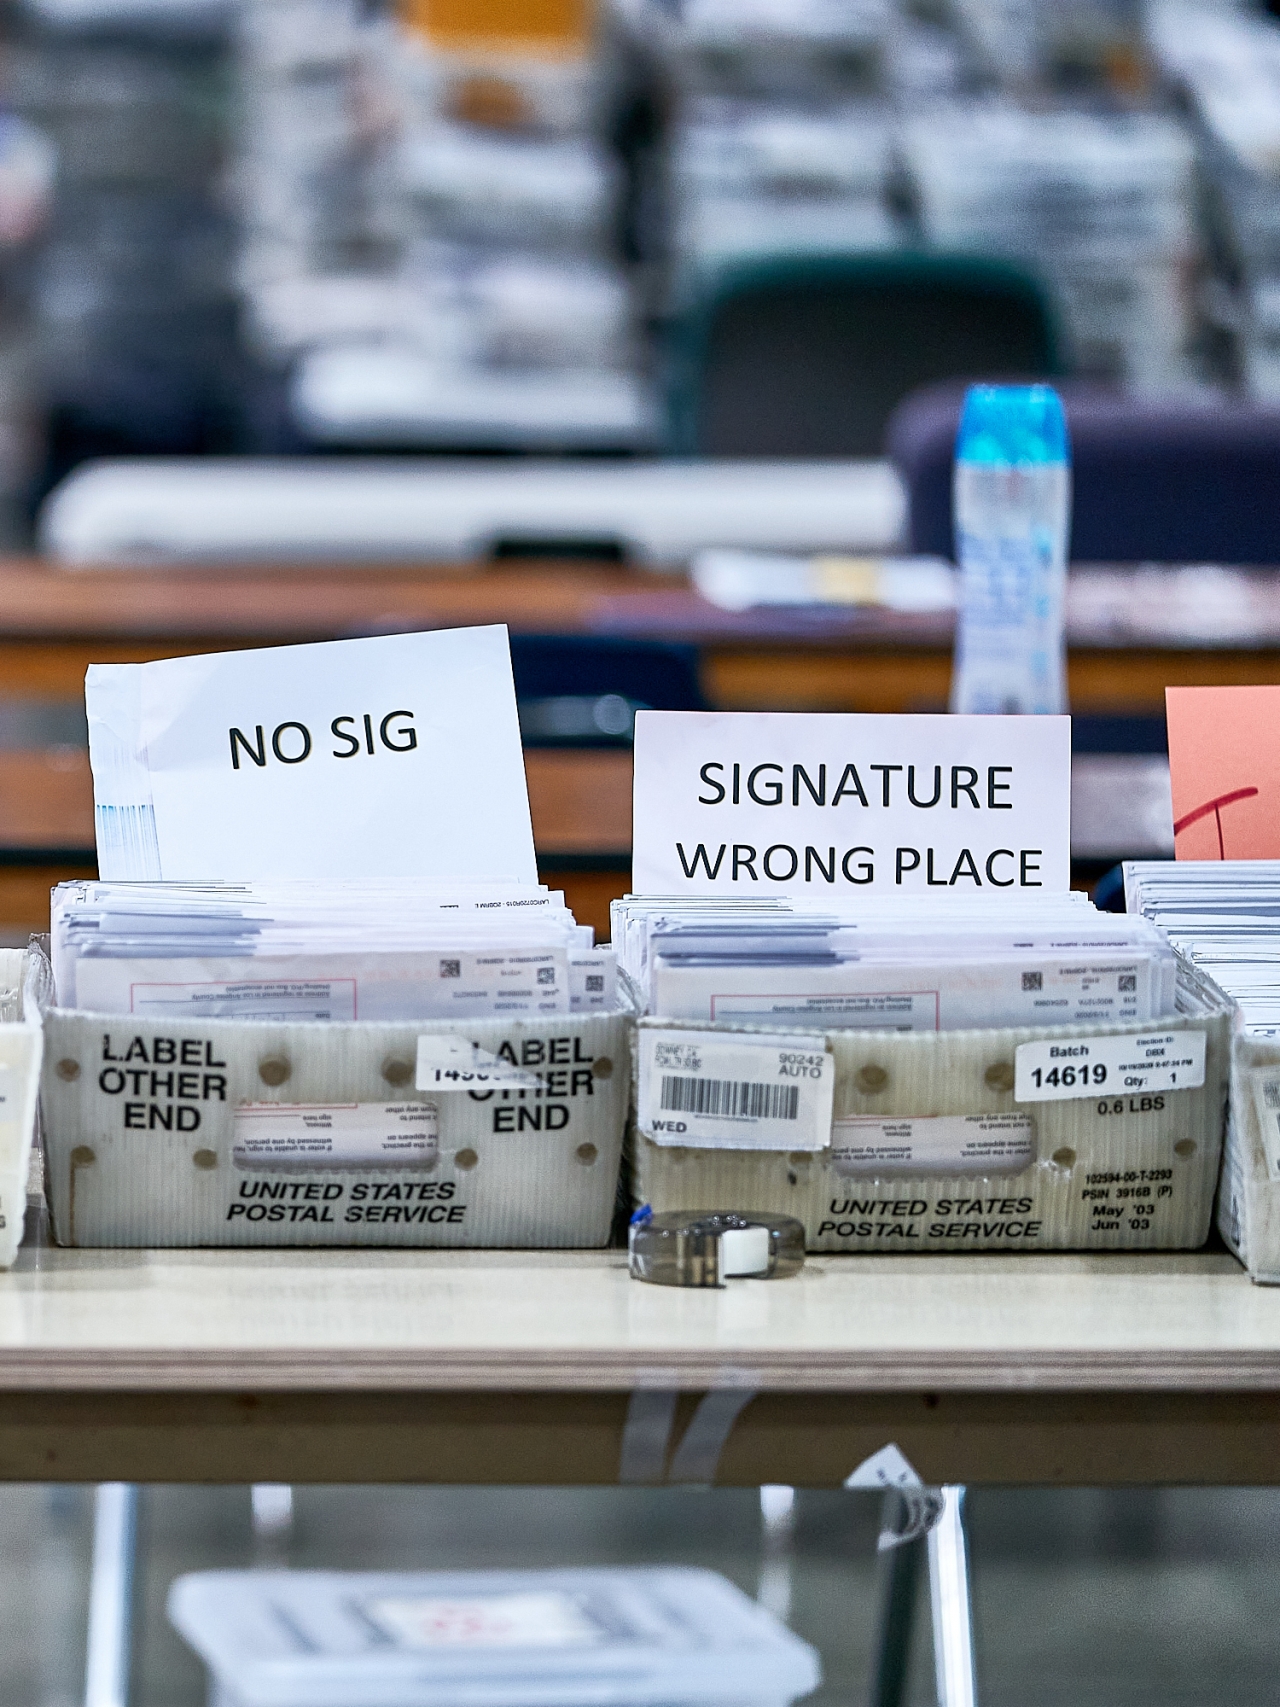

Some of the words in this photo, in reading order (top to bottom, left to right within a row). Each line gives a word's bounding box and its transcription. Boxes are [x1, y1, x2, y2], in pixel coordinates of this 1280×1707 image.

[230, 722, 313, 771] NO
[331, 711, 419, 759] SIG
[699, 763, 1014, 810] SIGNATURE
[676, 843, 875, 886] WRONG
[896, 848, 1044, 888] PLACE
[215, 992, 241, 1000] Angeles
[262, 991, 294, 999] registered
[103, 1034, 227, 1068] LABEL
[778, 1053, 824, 1067] 90242
[1050, 1045, 1089, 1058] Batch
[778, 1066, 822, 1079] AUTO
[1030, 1063, 1107, 1088] 14619
[1124, 1076, 1147, 1089] Qty:
[1170, 1072, 1176, 1083] 1
[99, 1067, 227, 1101] OTHER
[468, 1069, 594, 1102] HER
[1097, 1101, 1124, 1115] 0.6
[1129, 1096, 1165, 1112] LBS
[124, 1102, 201, 1132] END
[493, 1104, 569, 1133] END
[652, 1120, 687, 1133] WED
[398, 1133, 426, 1141] appears
[976, 1140, 1003, 1148] appears
[239, 1181, 343, 1201] UNITED
[350, 1181, 456, 1201] STATES
[1082, 1189, 1109, 1200] PSIN
[1116, 1187, 1151, 1198] 3916B
[1157, 1186, 1173, 1198] (P)
[226, 1204, 335, 1222] POSTAL
[344, 1205, 467, 1223] SERVICE
[830, 1198, 927, 1216] UNITED
[934, 1197, 1033, 1215] STATES
[1093, 1206, 1124, 1217] May
[1133, 1204, 1155, 1214] '03
[817, 1221, 920, 1237] POSTAL
[928, 1221, 1043, 1238] SERVICE
[1091, 1220, 1120, 1230] Jun
[1128, 1219, 1150, 1230] '03
